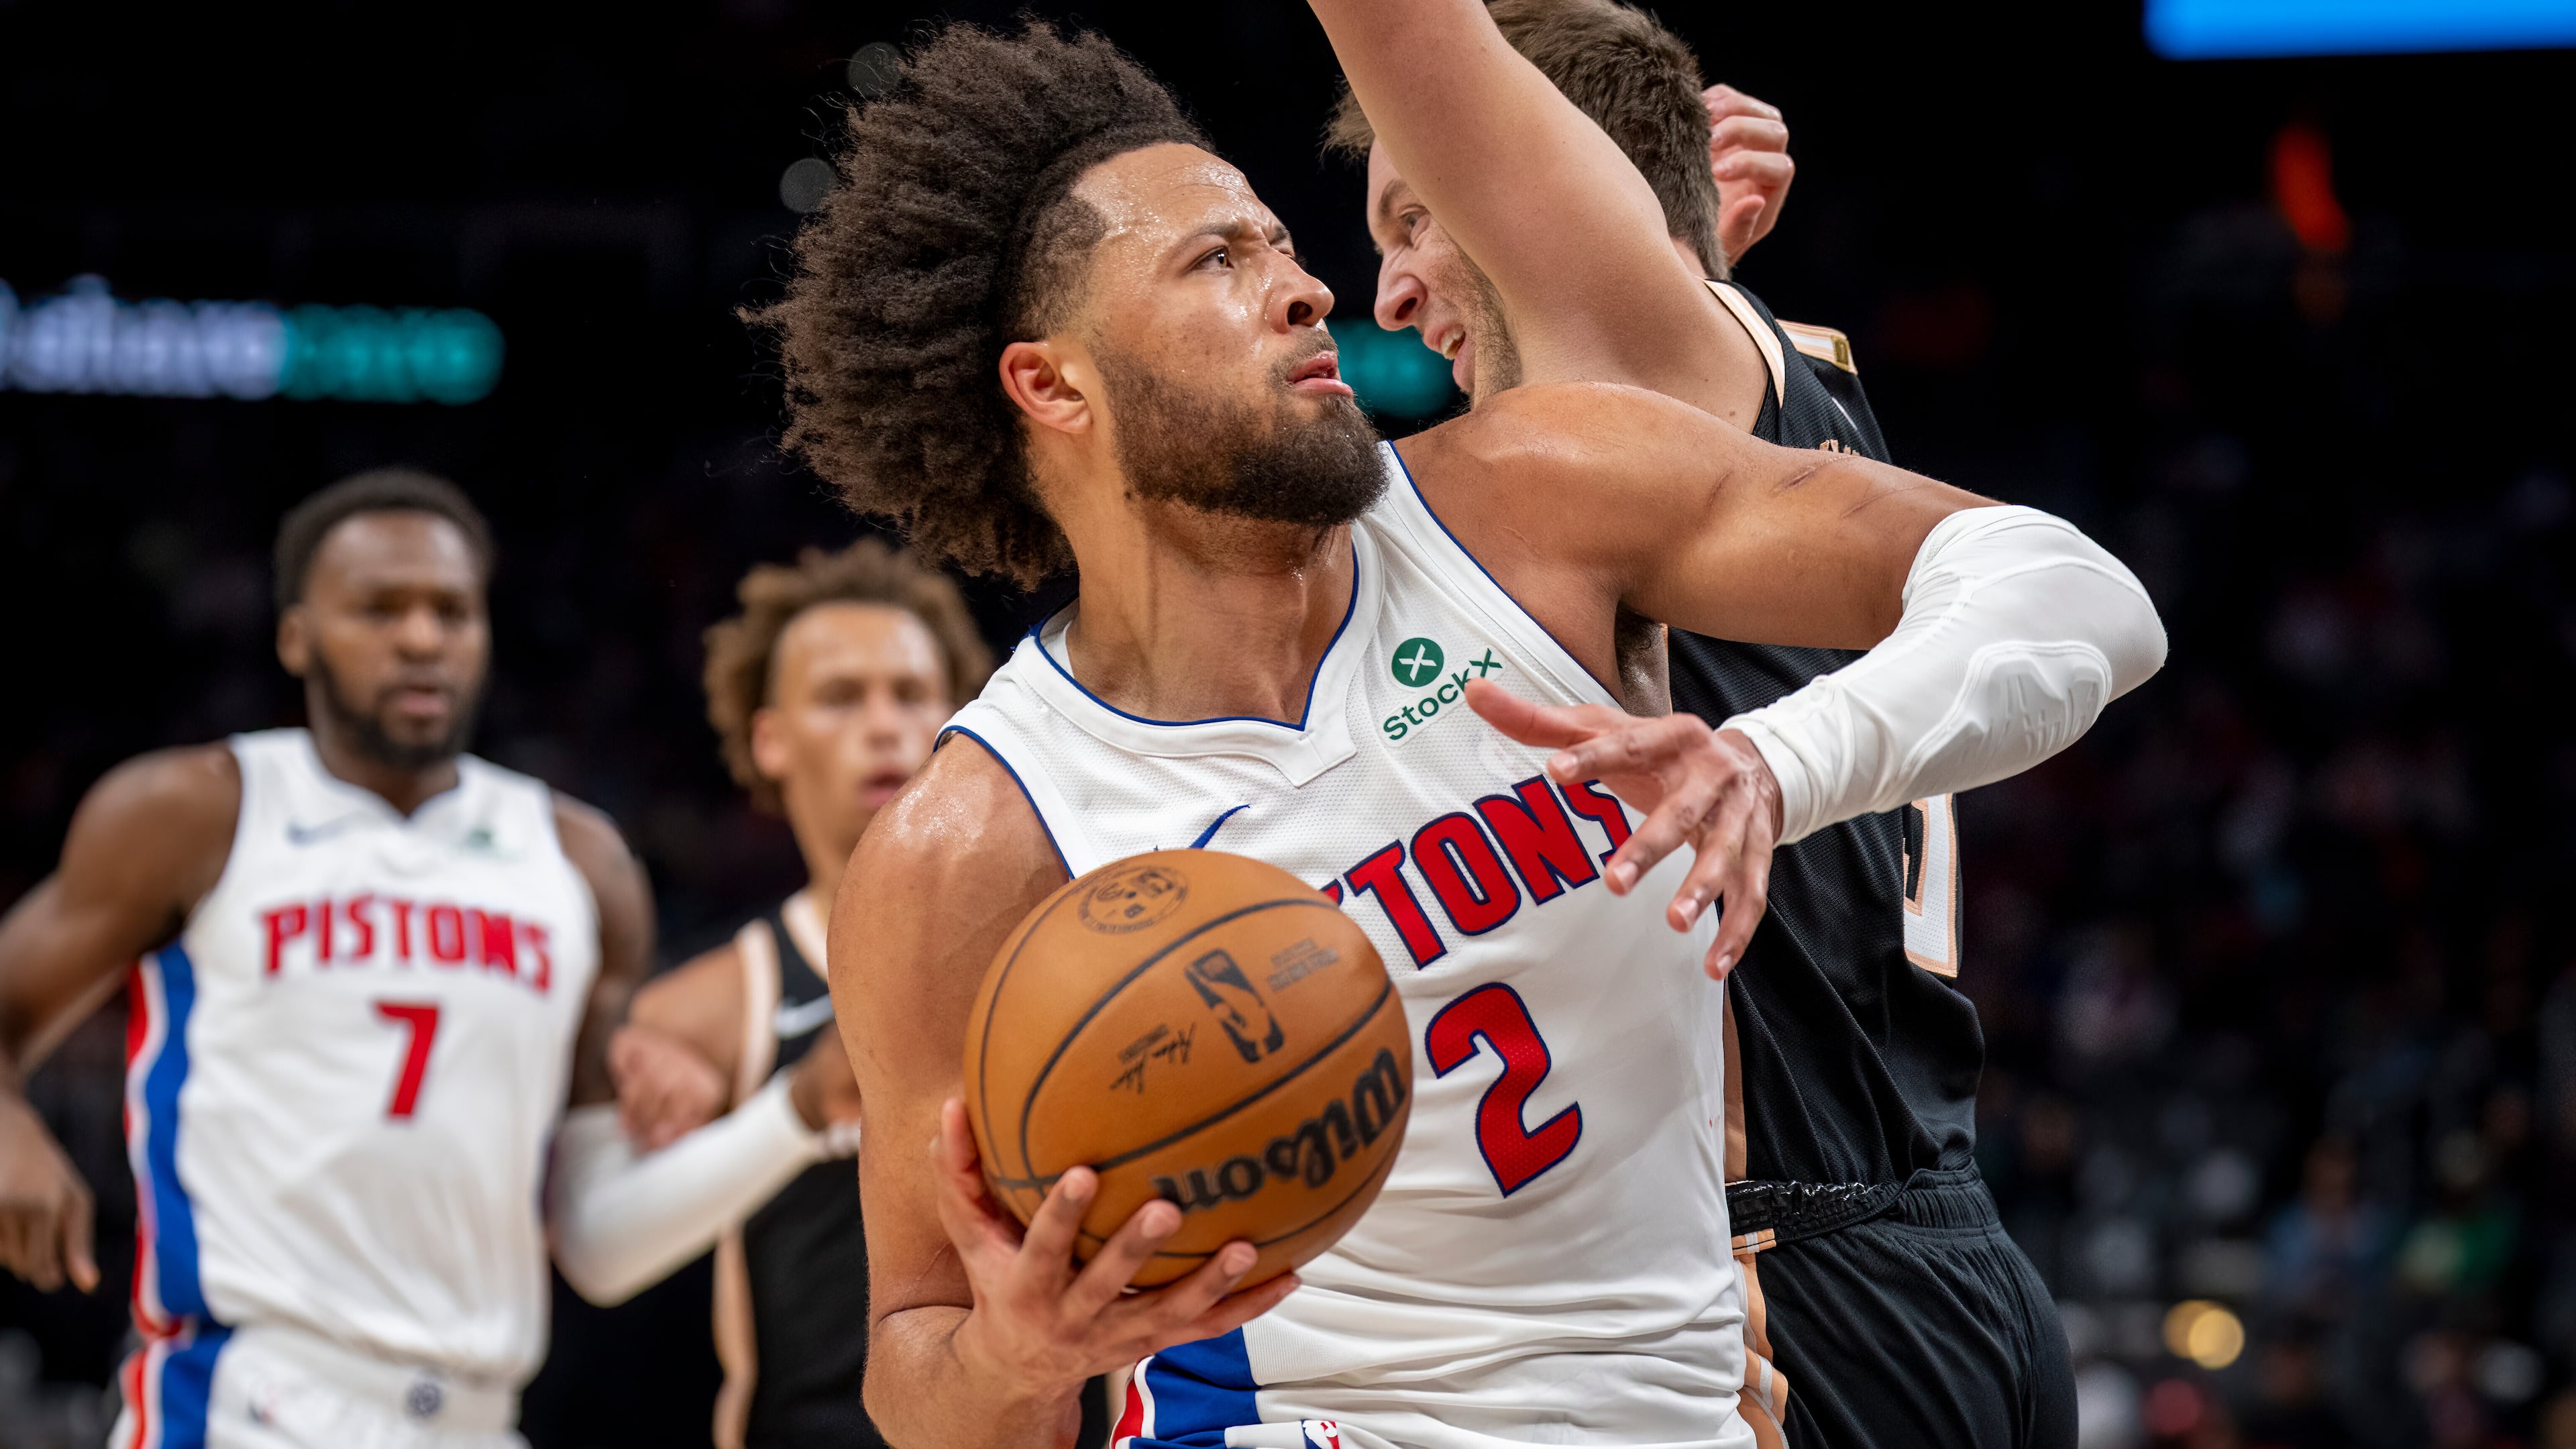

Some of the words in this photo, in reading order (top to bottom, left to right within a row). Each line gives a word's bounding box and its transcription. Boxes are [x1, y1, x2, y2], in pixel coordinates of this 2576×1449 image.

[1383, 648, 1503, 740] StockX
[258, 891, 554, 998] PISTONS
[1320, 773, 1632, 971] TONS
[372, 998, 442, 1123] 7
[1151, 1048, 1406, 1214] Wilson
[1424, 981, 1583, 1198] 2
